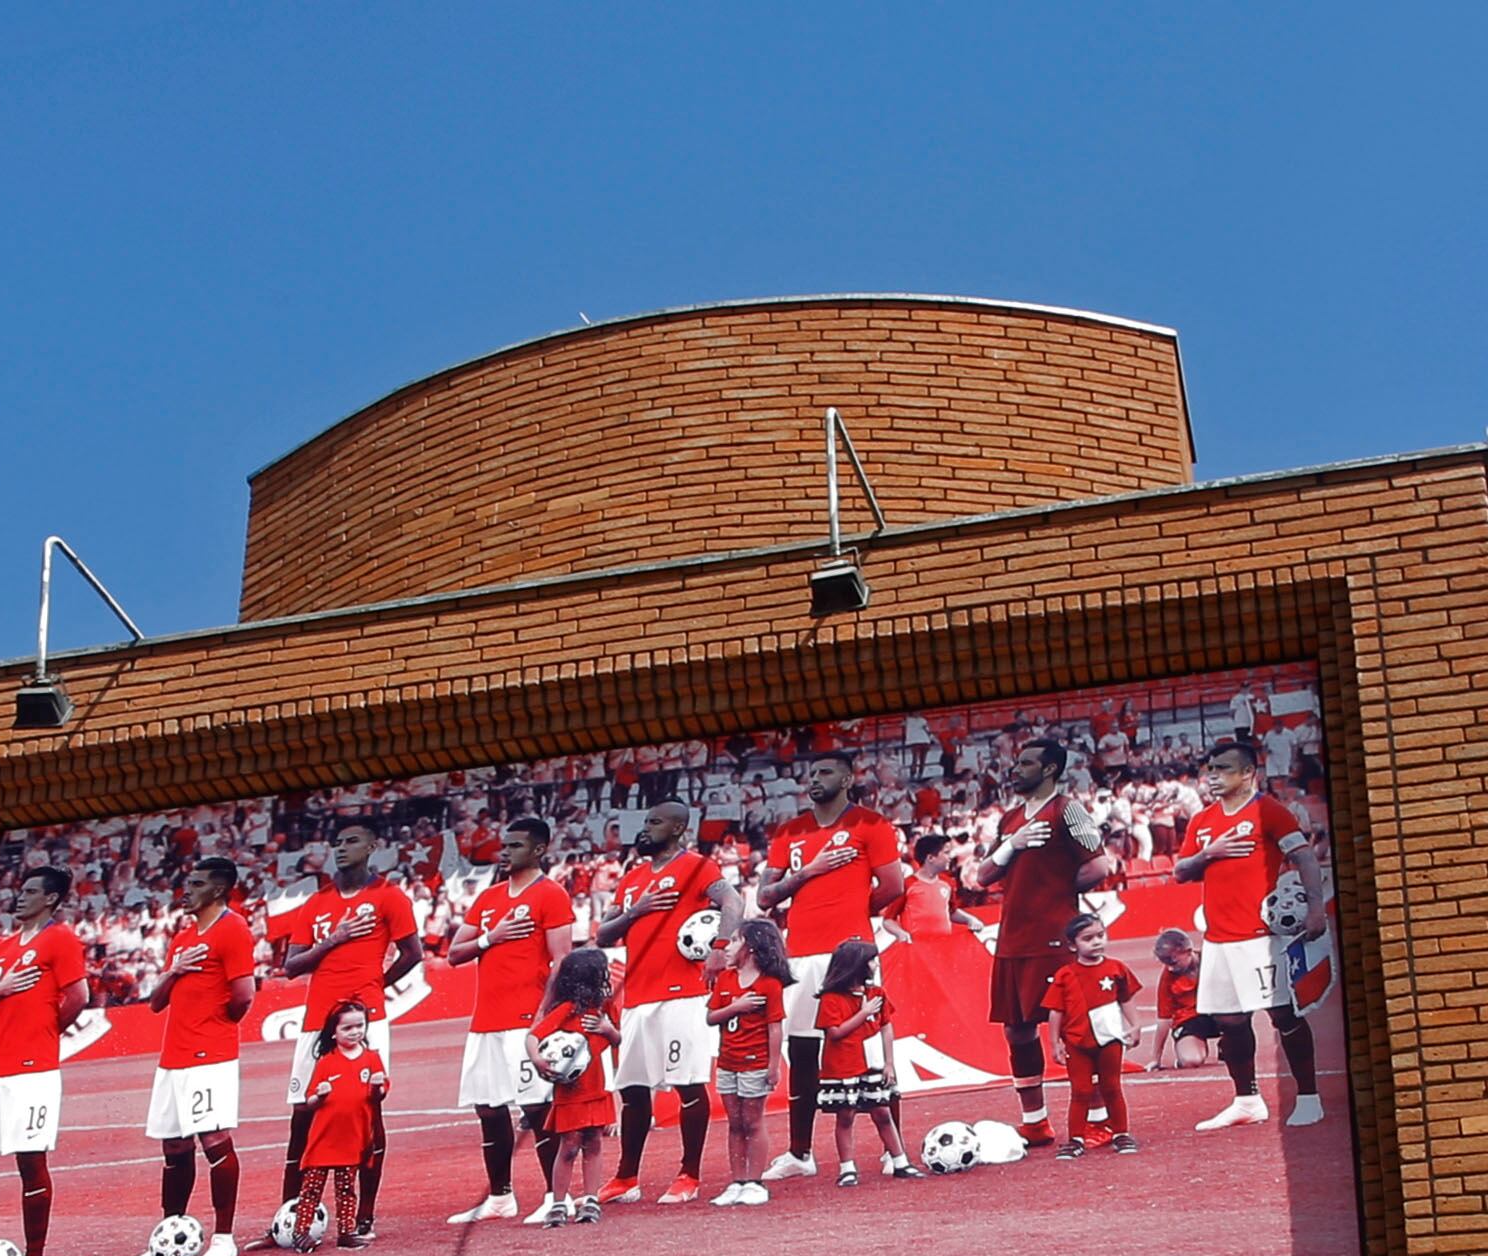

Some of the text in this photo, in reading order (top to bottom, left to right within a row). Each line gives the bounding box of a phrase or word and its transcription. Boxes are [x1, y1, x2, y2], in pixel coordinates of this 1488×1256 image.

[790, 848, 802, 871] 6
[312, 921, 332, 943] 13
[1255, 964, 1277, 990] 17
[669, 1040, 681, 1063] 8
[520, 1060, 533, 1083] 5
[192, 1088, 213, 1115] 21
[26, 1105, 47, 1130] 18
